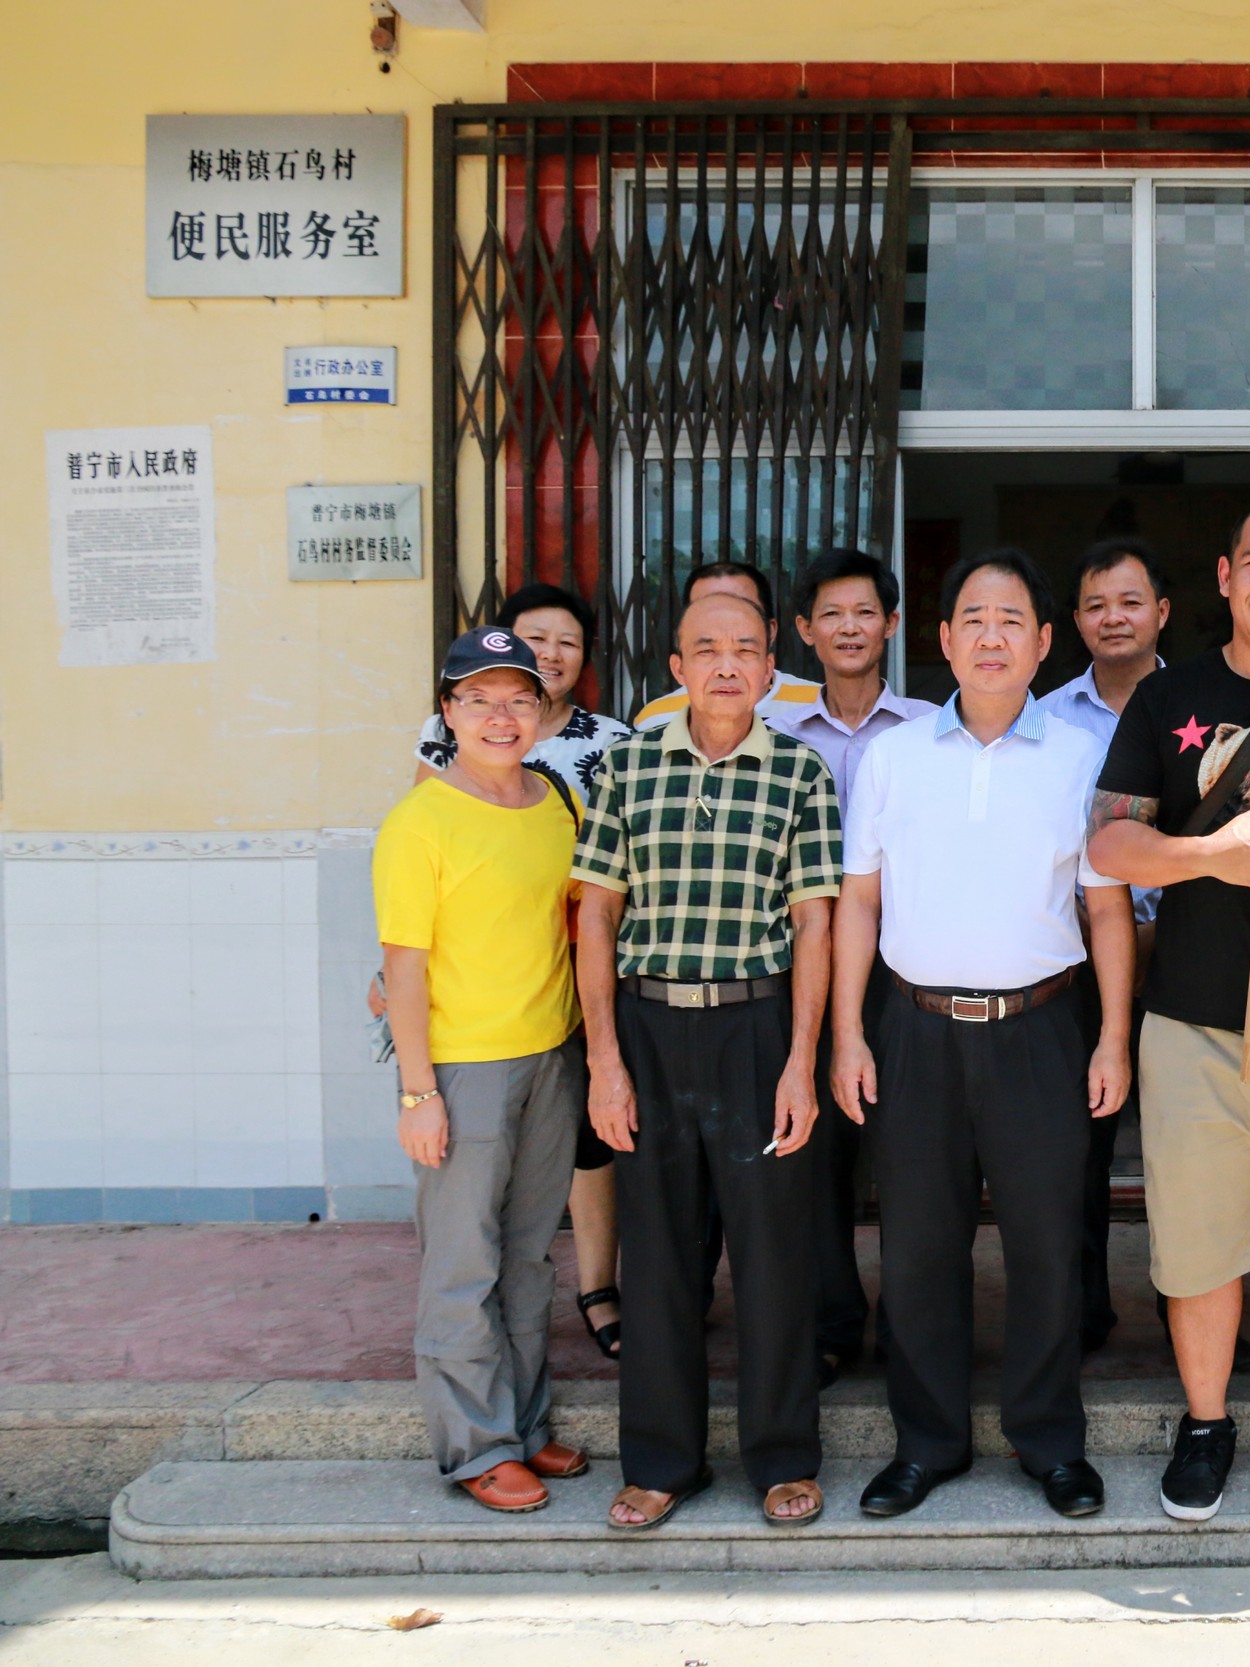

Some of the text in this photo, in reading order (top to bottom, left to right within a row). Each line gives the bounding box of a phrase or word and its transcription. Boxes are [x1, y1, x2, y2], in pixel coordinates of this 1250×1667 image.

[188, 148, 357, 182] 梅塘镇石鸟村
[168, 210, 380, 260] 便民服务室
[315, 359, 383, 376] 行政办公室
[67, 448, 197, 479] 普宁市人民政府
[312, 502, 397, 522] 普宁市梅塘镇
[297, 536, 411, 563] 石鸟村村务监督委员会
